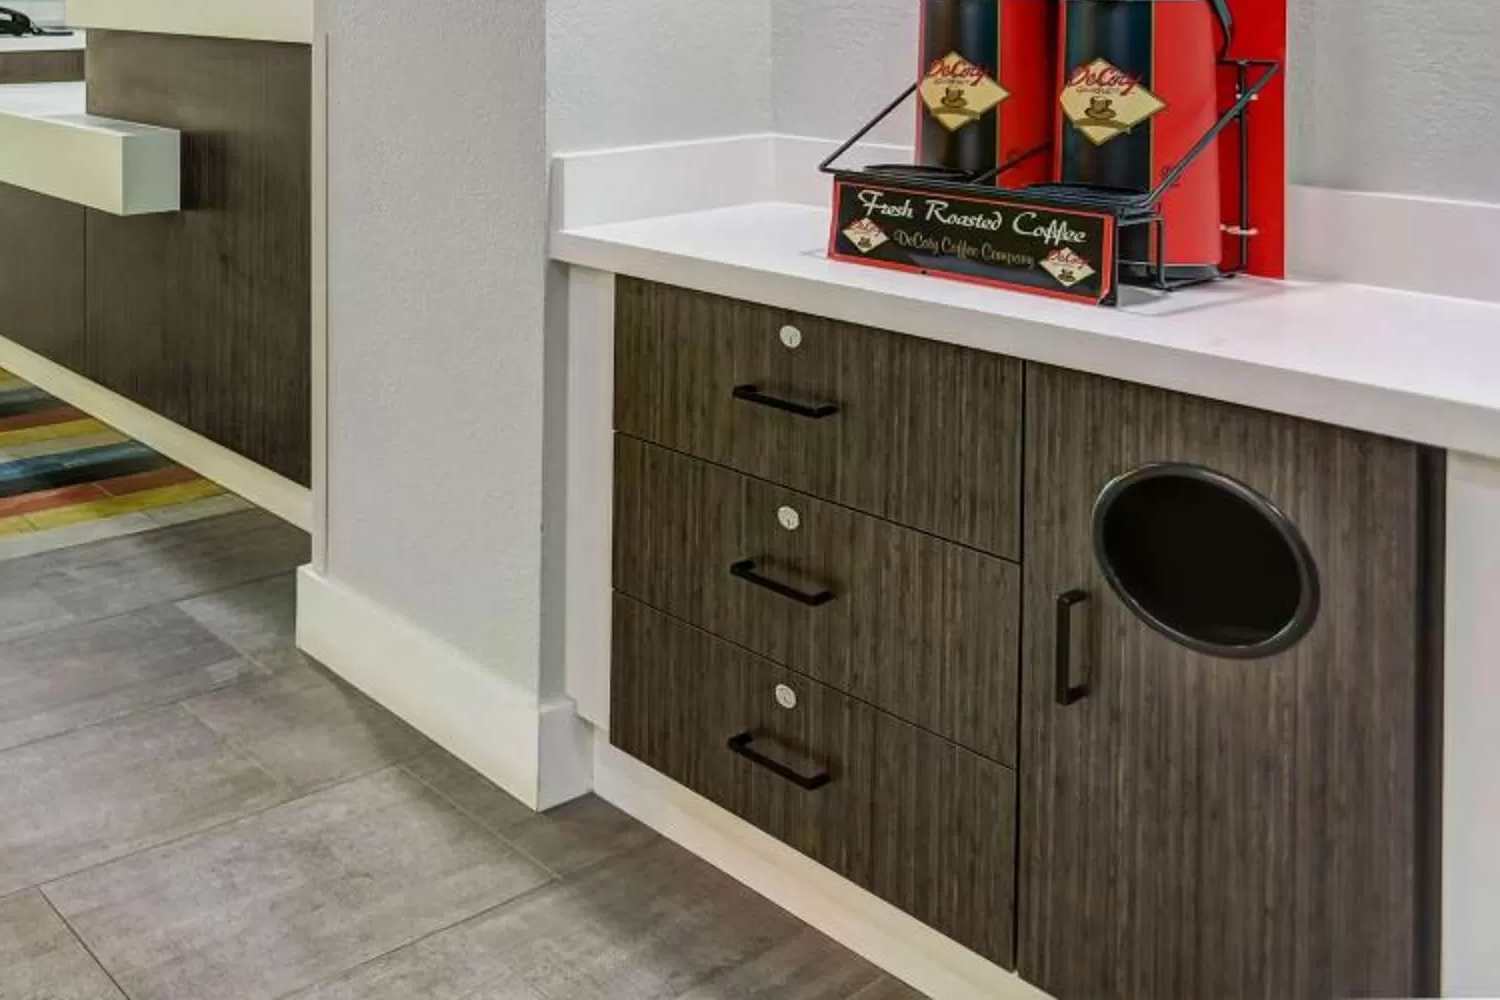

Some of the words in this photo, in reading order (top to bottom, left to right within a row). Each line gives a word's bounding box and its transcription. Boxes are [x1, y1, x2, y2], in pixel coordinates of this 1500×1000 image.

[858, 189, 913, 219] Fresh
[925, 199, 1003, 231] Roasted
[1011, 211, 1087, 246] Coffee
[940, 236, 979, 258] Coffee
[981, 242, 1034, 269] Company
